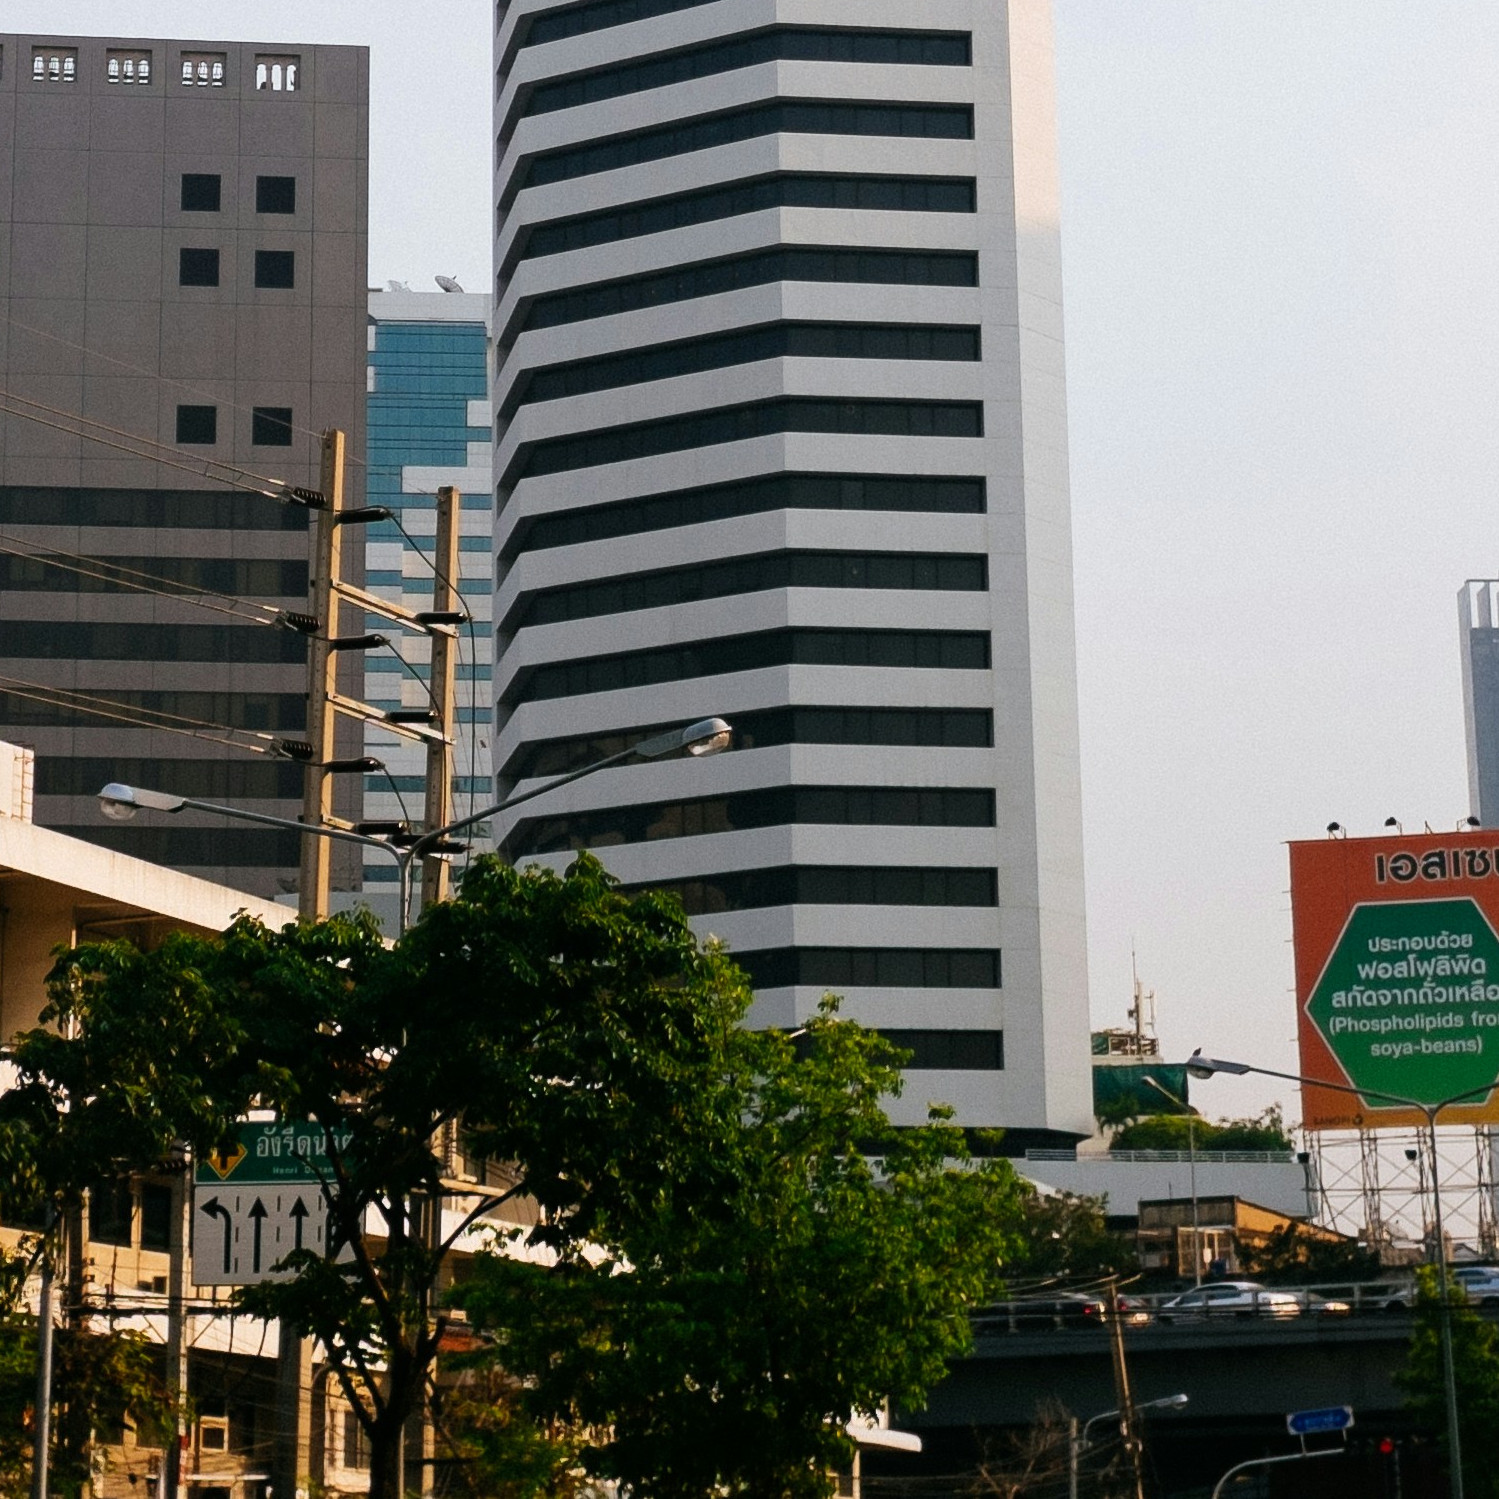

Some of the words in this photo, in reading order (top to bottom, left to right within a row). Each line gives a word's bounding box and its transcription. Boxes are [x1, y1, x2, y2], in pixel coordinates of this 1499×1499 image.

[1368, 931, 1473, 953] ประกอบด้วย
[1357, 954, 1486, 980] ฟอสโฟลิพิด
[1329, 1013, 1464, 1035] (Phospholipids
[1370, 1035, 1483, 1059] soya-beans)
